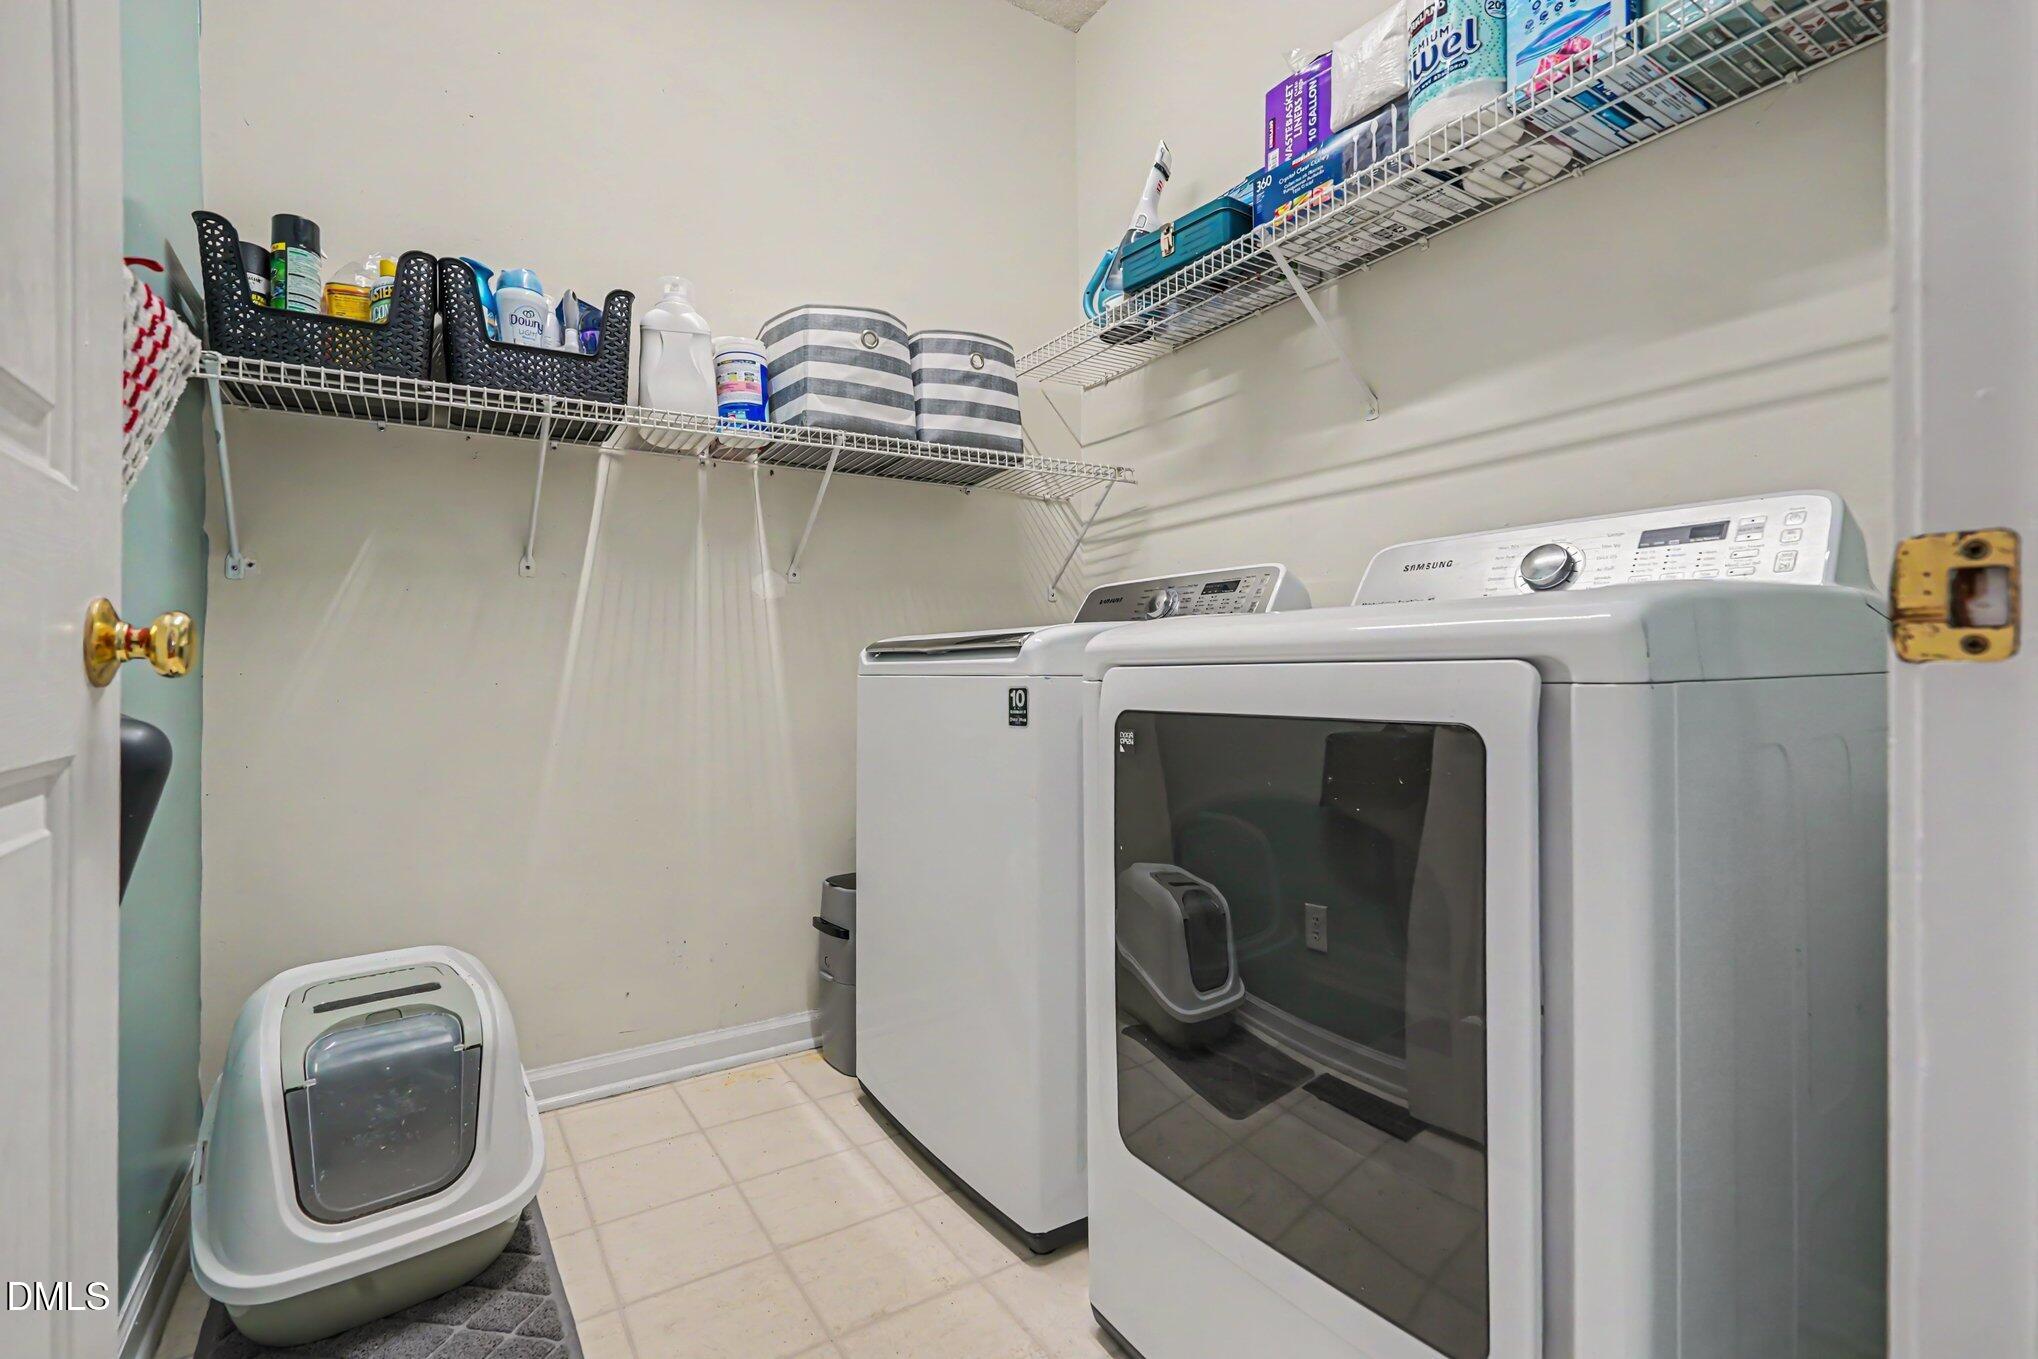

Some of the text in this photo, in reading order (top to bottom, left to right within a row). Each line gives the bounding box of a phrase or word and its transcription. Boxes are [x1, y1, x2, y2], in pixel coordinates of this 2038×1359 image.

[1408, 17, 1477, 82] wel
[1293, 97, 1303, 139] LINERS
[1308, 79, 1318, 142] 10 GALLON
[1256, 174, 1272, 193] 360
[510, 313, 544, 336] Downy
[1403, 559, 1454, 573] SAMSUNG
[1010, 689, 1026, 707] 10
